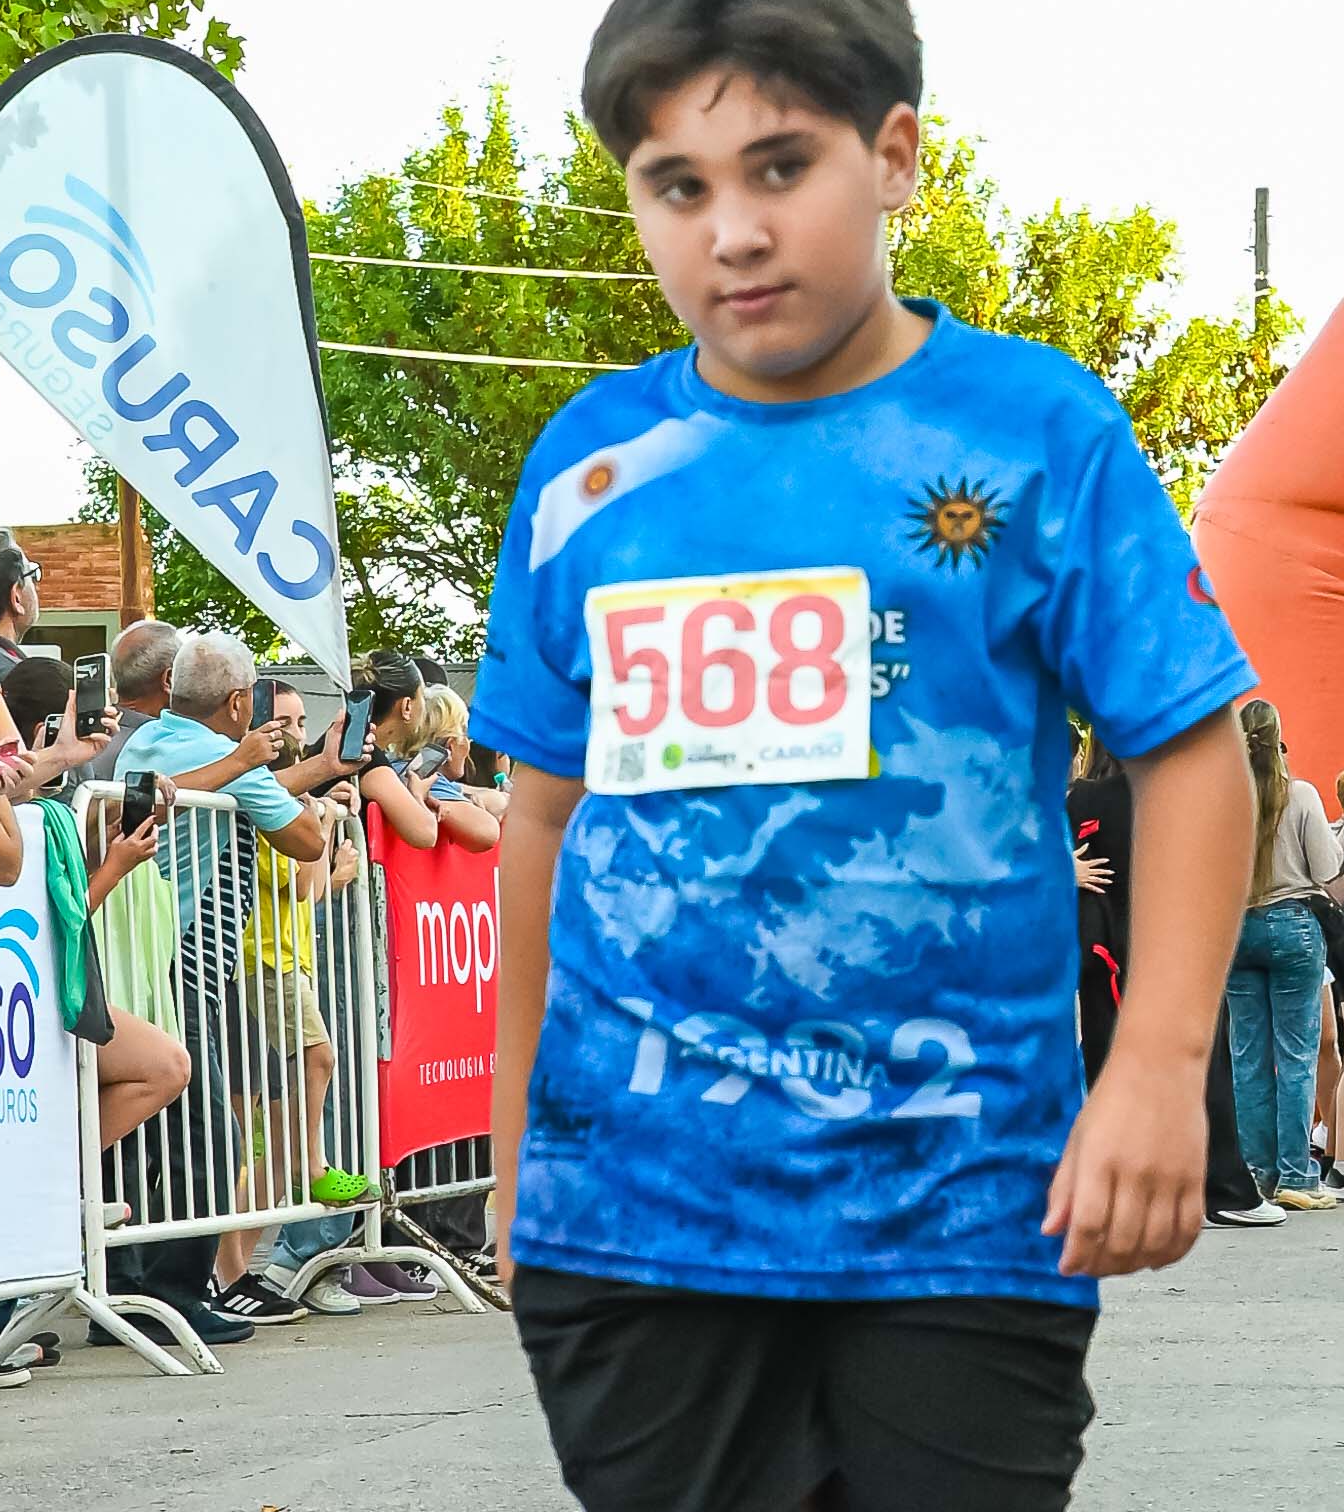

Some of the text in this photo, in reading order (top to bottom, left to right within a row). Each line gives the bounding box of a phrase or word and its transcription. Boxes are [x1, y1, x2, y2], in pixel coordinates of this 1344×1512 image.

[605, 594, 848, 737] 568
[419, 1052, 498, 1086] TECNOLOGIA E
